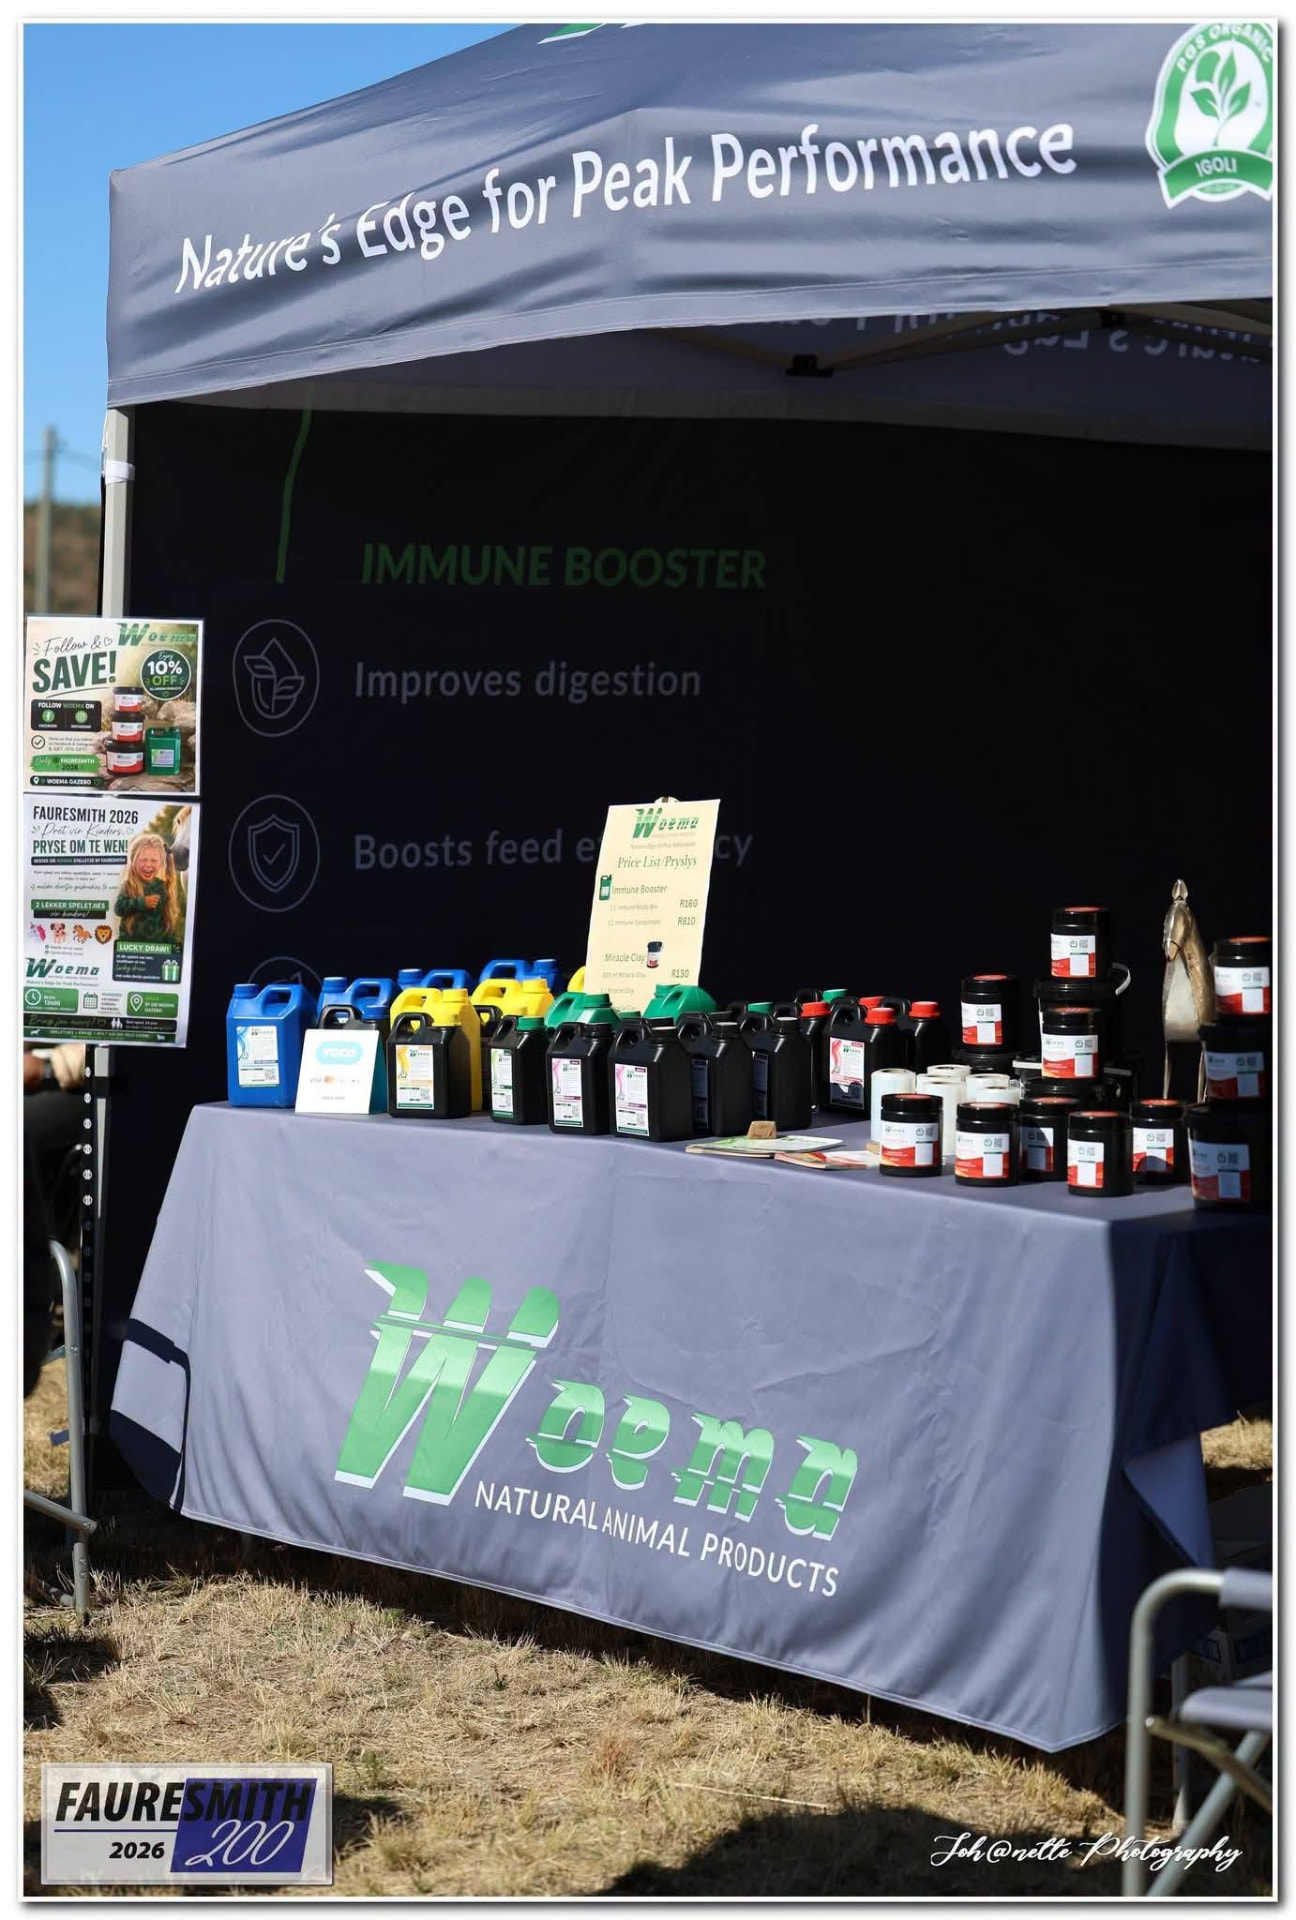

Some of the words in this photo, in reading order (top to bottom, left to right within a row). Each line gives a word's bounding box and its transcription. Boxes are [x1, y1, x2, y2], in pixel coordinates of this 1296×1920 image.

[1194, 156, 1238, 177] IGOLI
[174, 212, 341, 294] Nature's
[356, 192, 471, 260] Edge
[483, 168, 556, 234] for
[572, 136, 692, 218] Peak
[712, 123, 1077, 202] Performance
[361, 543, 553, 587] IMMUNE
[565, 548, 767, 589] BOOSTER
[44, 638, 87, 657] Follow
[91, 635, 102, 650] &
[32, 650, 117, 694] SAVE!
[147, 660, 183, 675] 10%
[152, 675, 178, 686] OFF
[355, 662, 521, 703] Improves
[535, 662, 701, 703] digestion
[33, 805, 106, 823] FAURESMITH
[109, 809, 139, 825] 2026
[632, 808, 700, 838] Woema
[41, 822, 67, 840] Pret
[33, 840, 66, 853] PRYSE
[70, 840, 86, 853] OM
[89, 840, 101, 853] TE
[104, 840, 128, 853] WEN!
[355, 833, 472, 870] Boosts
[486, 829, 561, 865] feed
[618, 855, 642, 869] Price
[612, 886, 640, 895] Immune
[640, 884, 667, 894] Booster
[679, 899, 699, 908] R160
[677, 916, 696, 926] R810
[119, 943, 144, 952] LUCKY
[145, 944, 170, 952] DRAW!
[24, 957, 100, 978] Woema
[604, 953, 630, 962] Miracle
[631, 952, 646, 964] Clay
[671, 969, 690, 978] R130
[335, 1260, 858, 1541] Woema
[474, 1480, 598, 1531] NATURAL
[601, 1506, 690, 1558] ANIMAL
[701, 1532, 840, 1597] PRODUCTS
